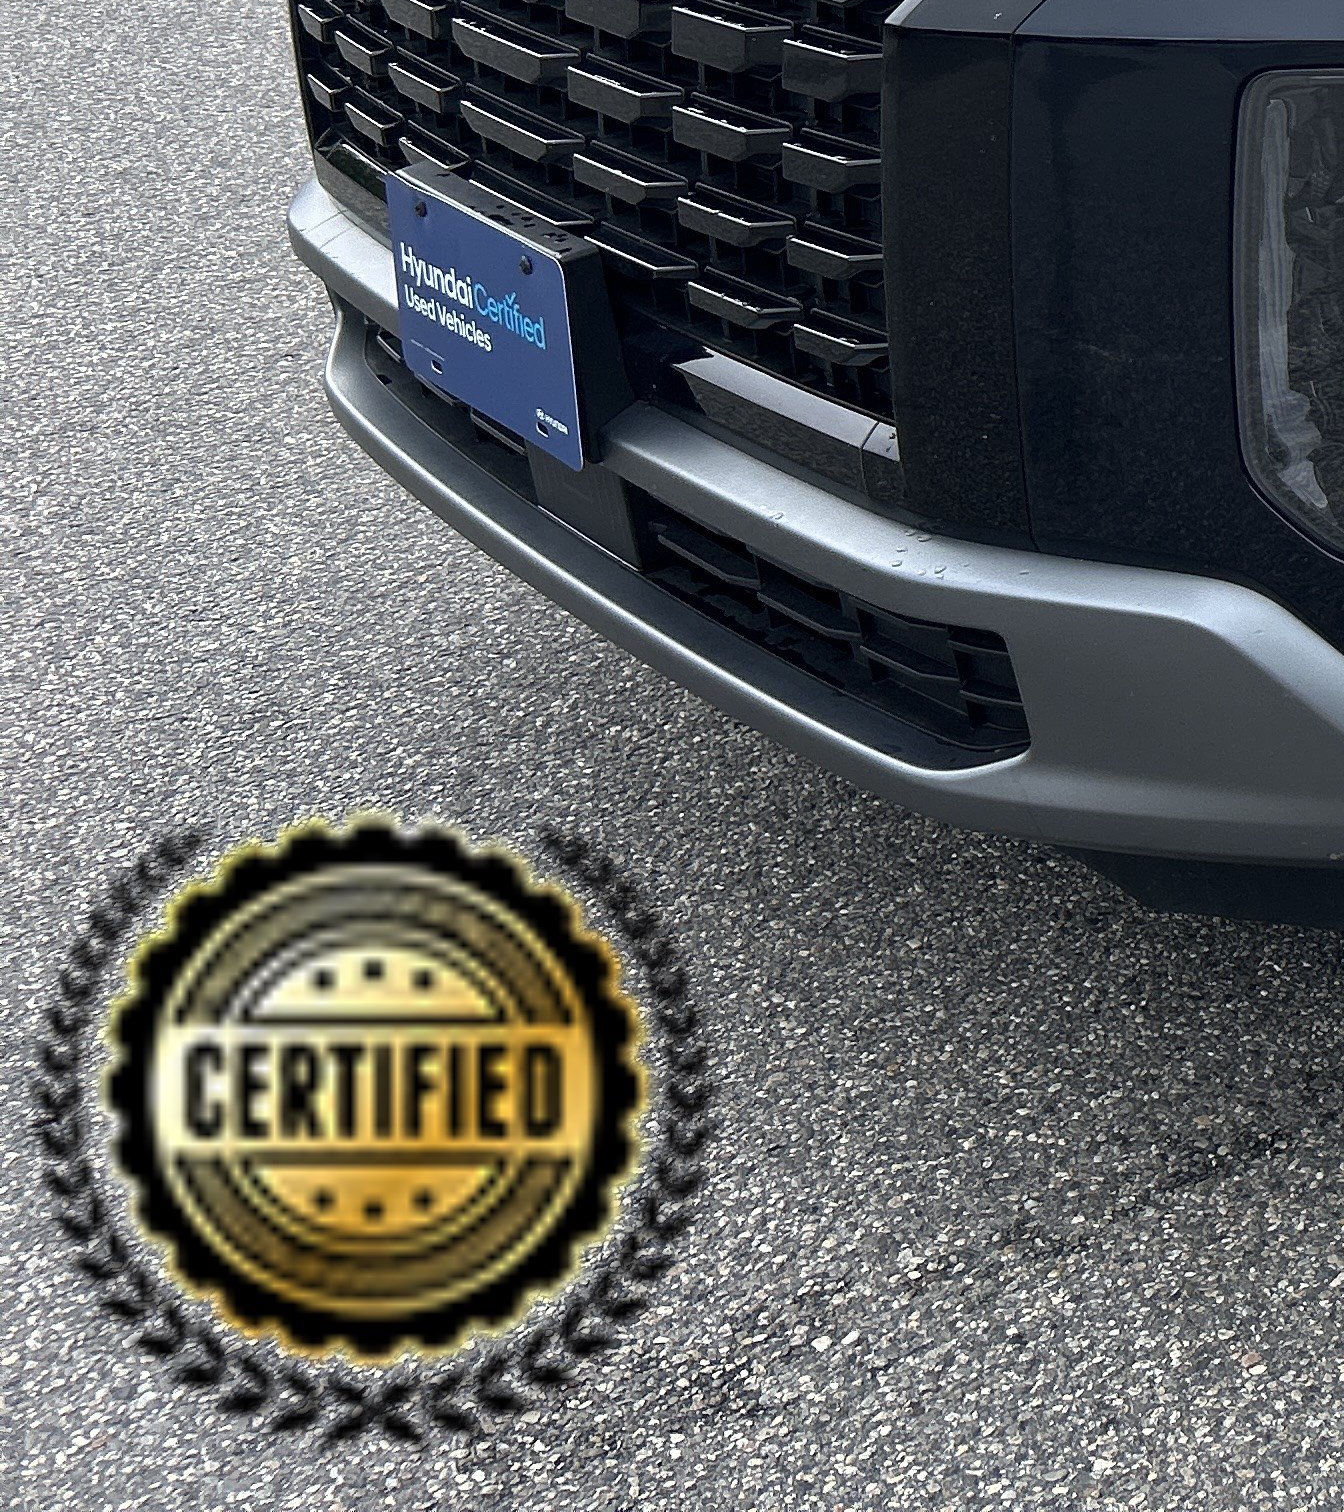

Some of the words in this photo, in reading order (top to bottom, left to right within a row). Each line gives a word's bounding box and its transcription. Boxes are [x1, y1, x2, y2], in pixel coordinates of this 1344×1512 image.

[400, 242, 474, 310] Hyundai
[473, 281, 547, 350] Certified
[404, 283, 437, 323] Used
[436, 302, 492, 352] Vehicles
